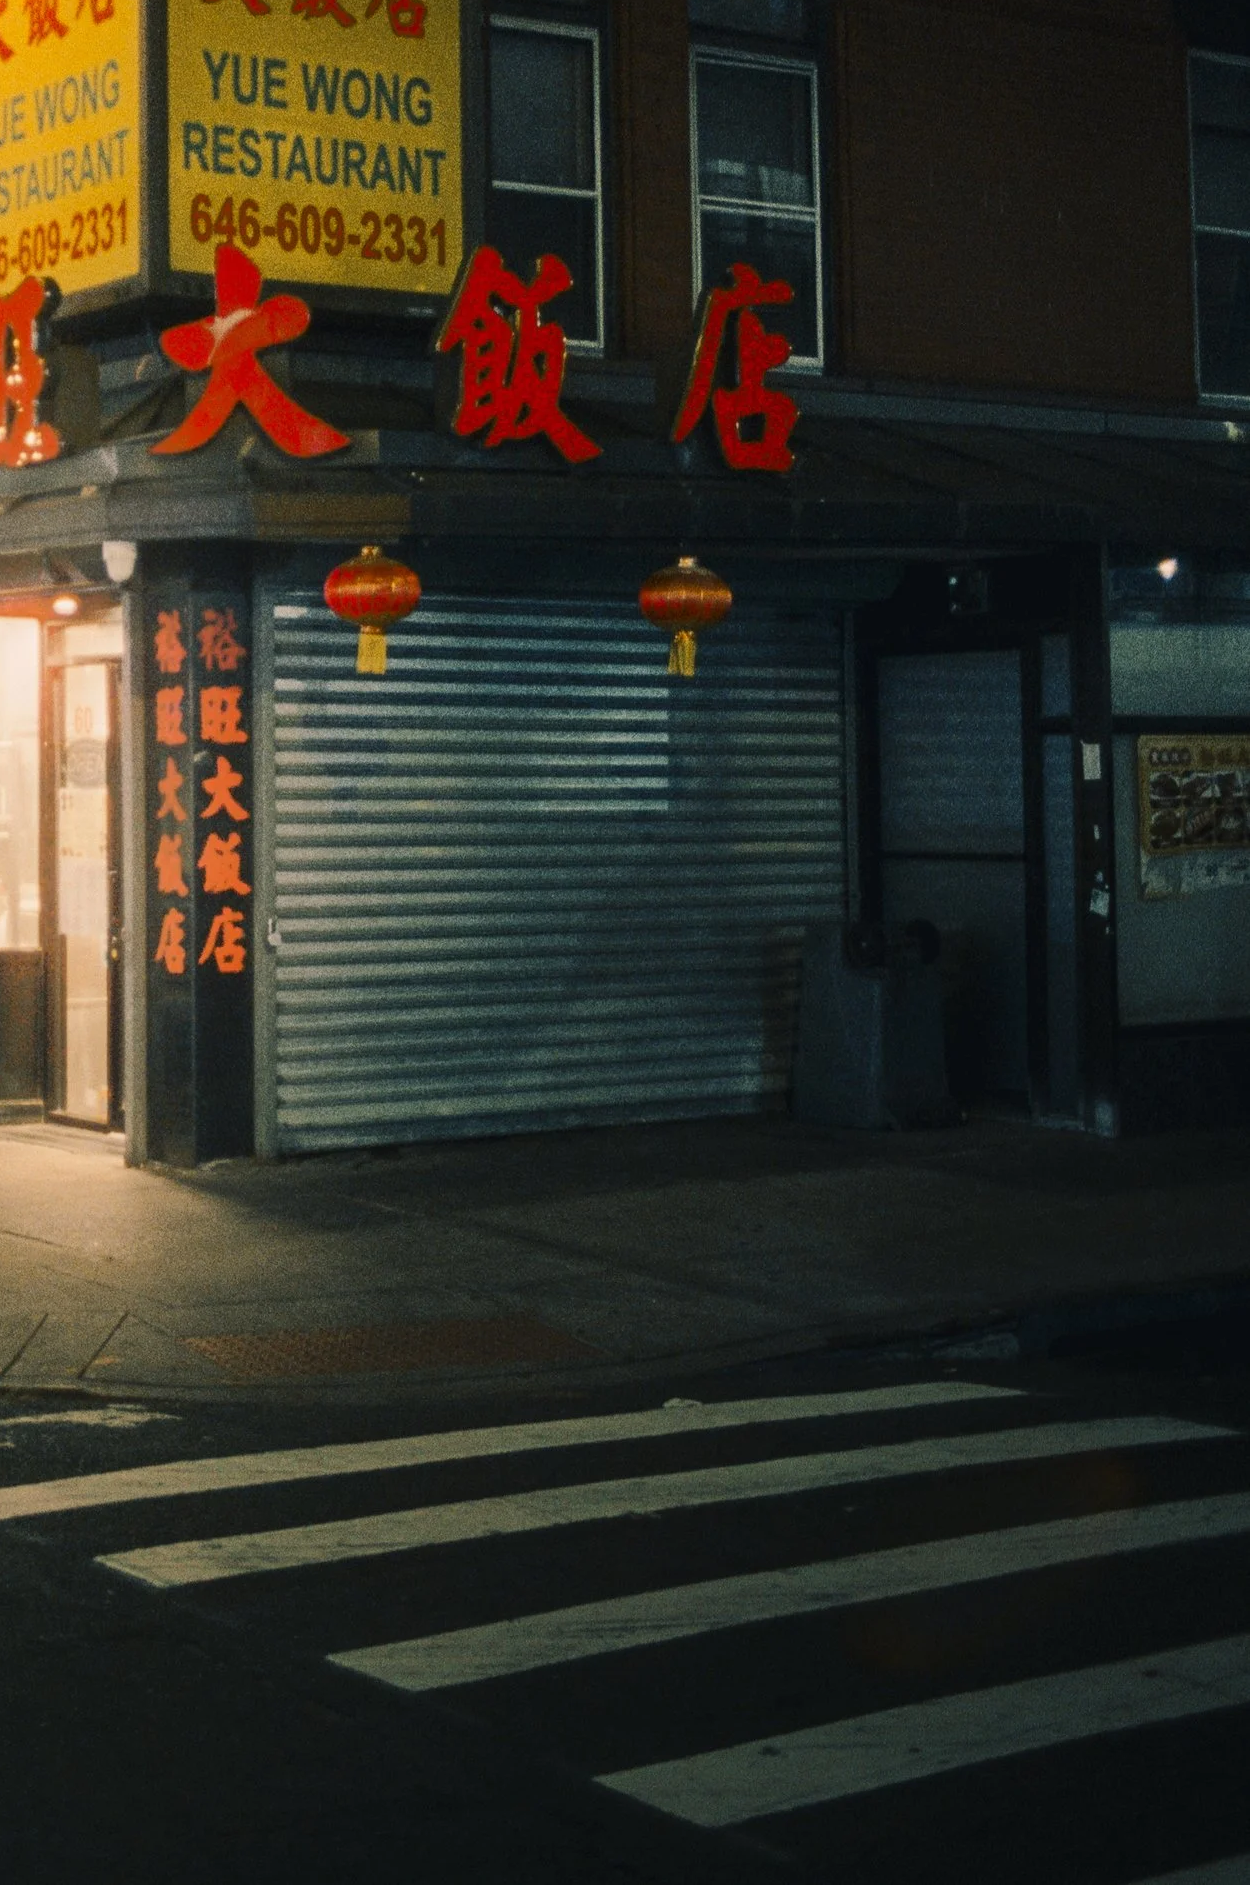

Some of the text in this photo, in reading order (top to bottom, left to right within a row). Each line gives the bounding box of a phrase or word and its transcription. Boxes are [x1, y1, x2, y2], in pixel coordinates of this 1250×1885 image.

[33, 59, 122, 135] WONG
[202, 50, 434, 127] YUE WONG
[183, 121, 447, 197] RESTAURANT
[191, 193, 449, 267] 646-609-2331
[197, 608, 251, 974] 裕旺大飯店
